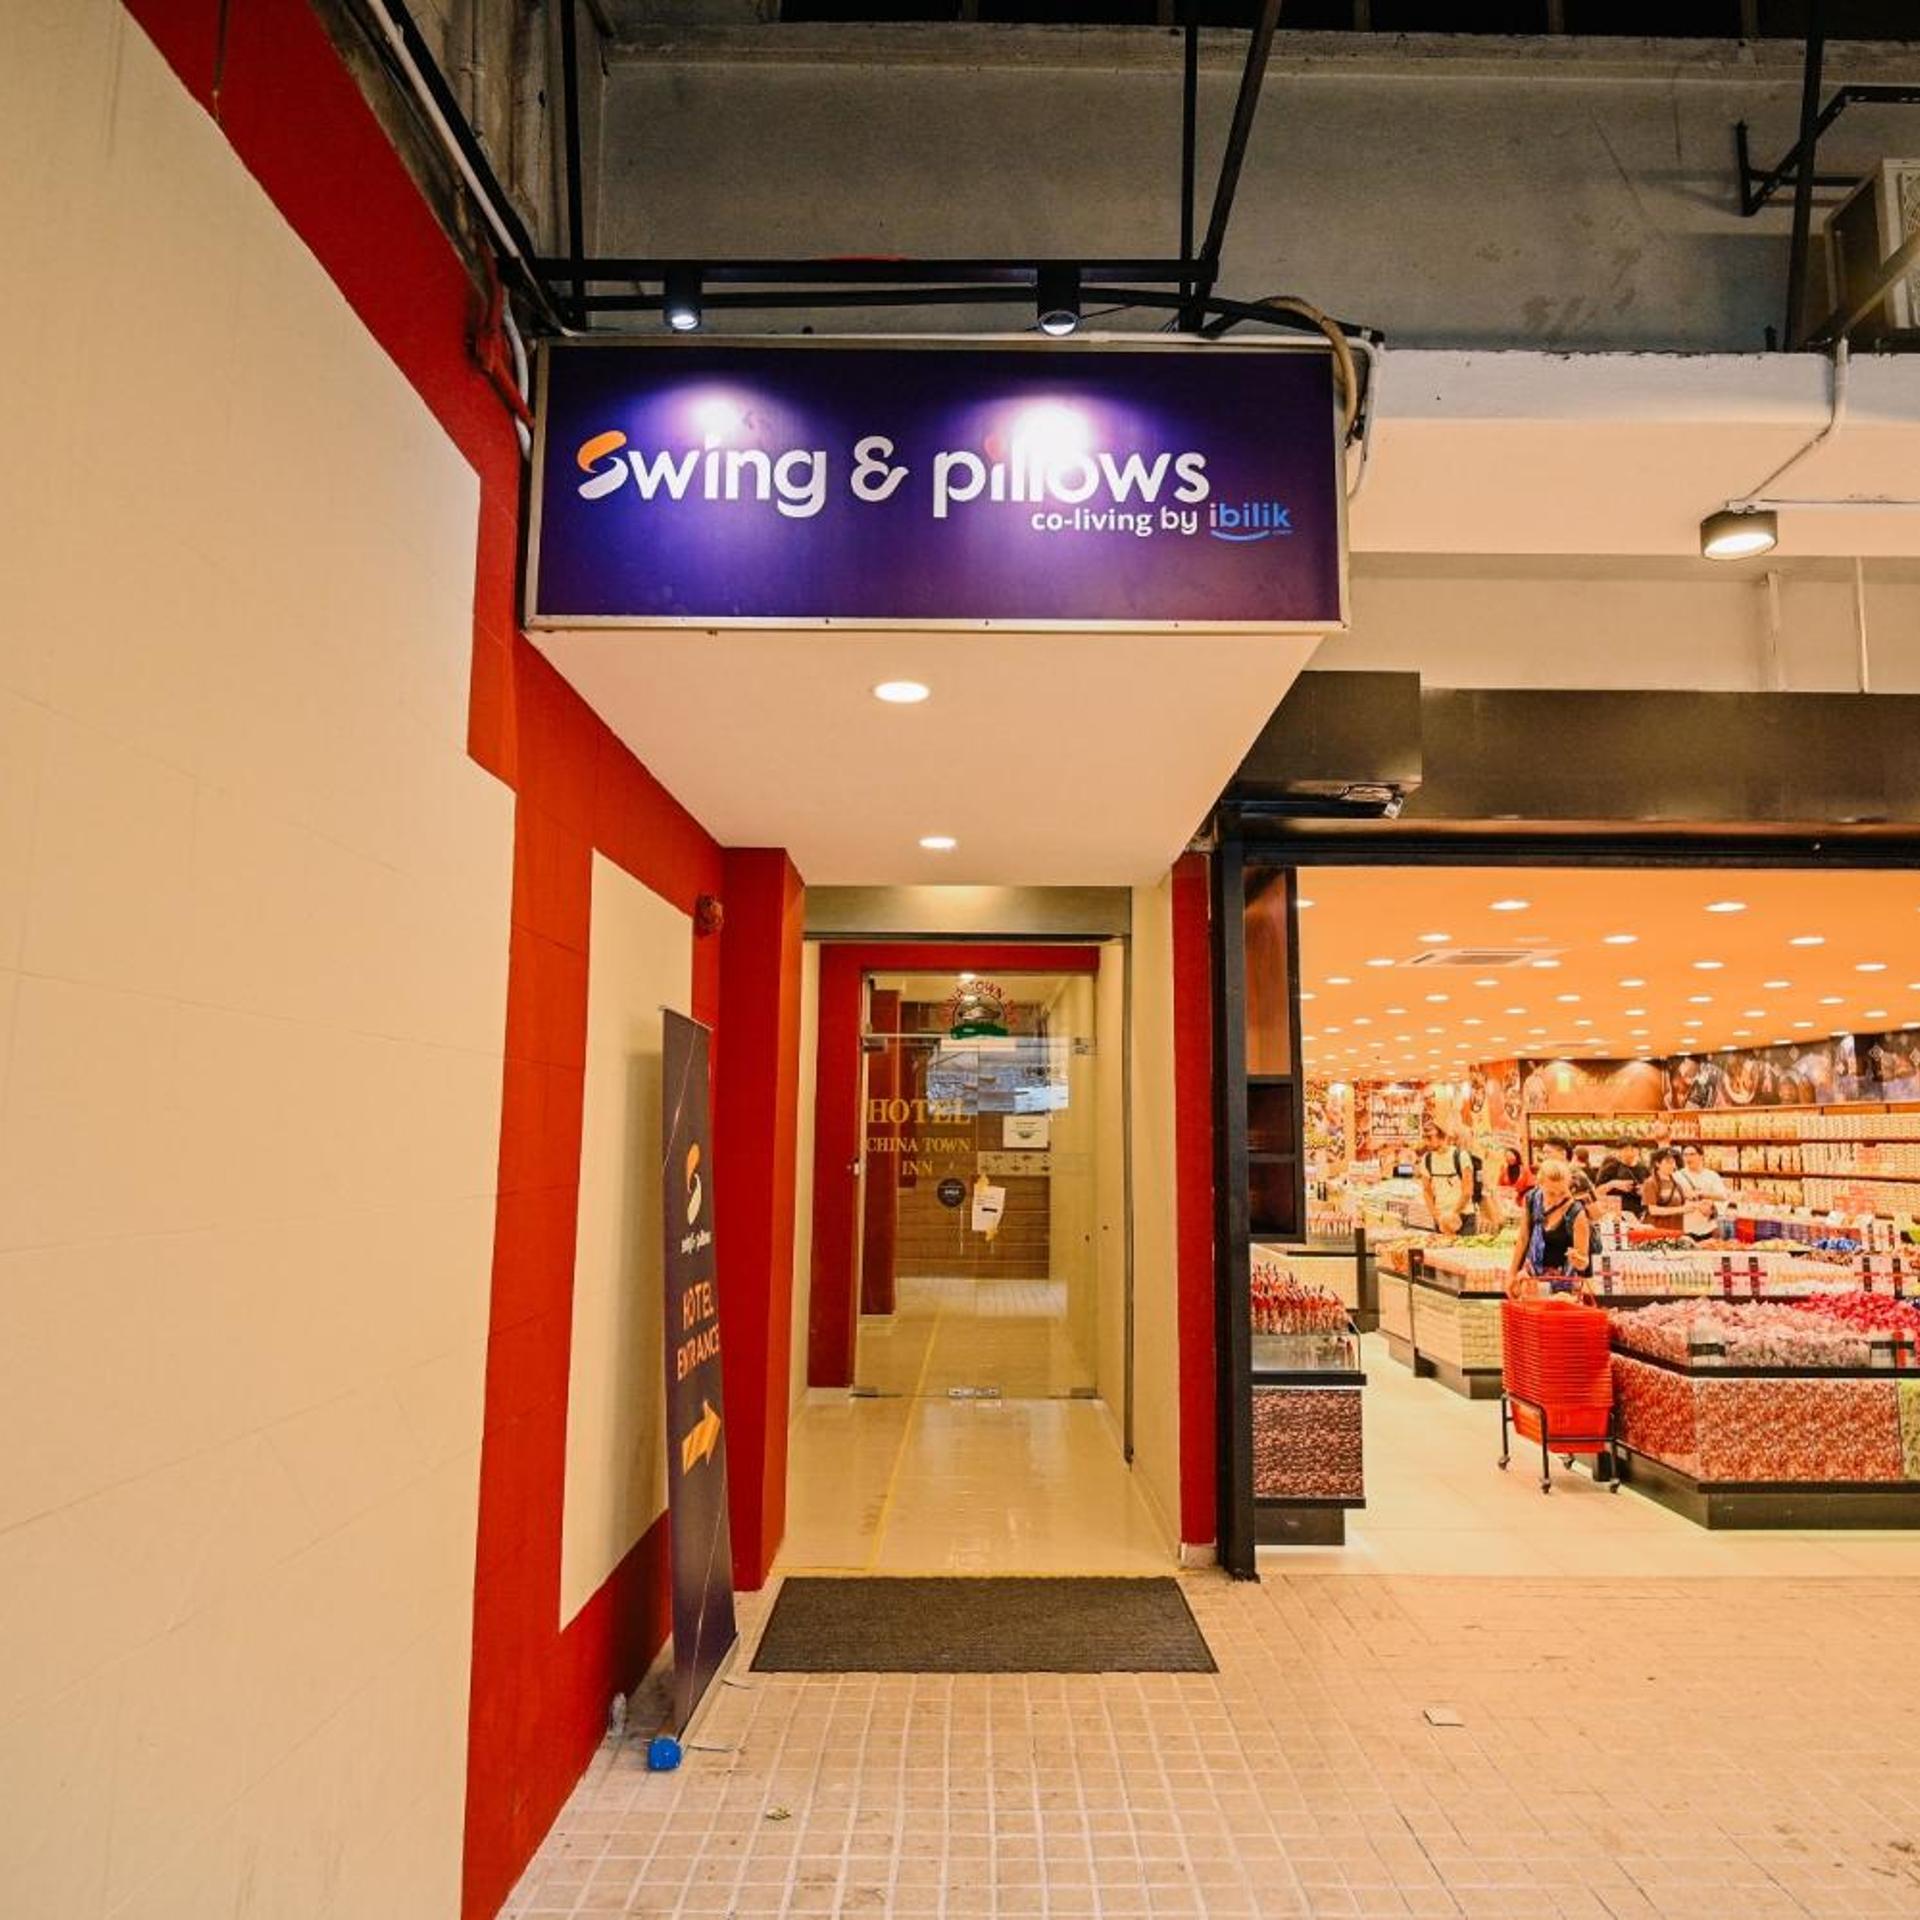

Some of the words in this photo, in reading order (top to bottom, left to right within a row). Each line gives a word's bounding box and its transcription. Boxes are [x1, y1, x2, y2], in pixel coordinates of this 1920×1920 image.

[577, 430, 827, 518] Swing
[851, 435, 909, 502] &
[933, 434, 1210, 518] pillows
[1031, 507, 1153, 537] co-living
[1160, 505, 1198, 535] by
[1209, 503, 1292, 528] ibilik
[867, 1098, 972, 1124] HOTEL
[866, 1137, 919, 1153] CHINA
[922, 1137, 972, 1153] TOWN
[902, 1160, 934, 1176] INN
[682, 1281, 714, 1331] HOTEL
